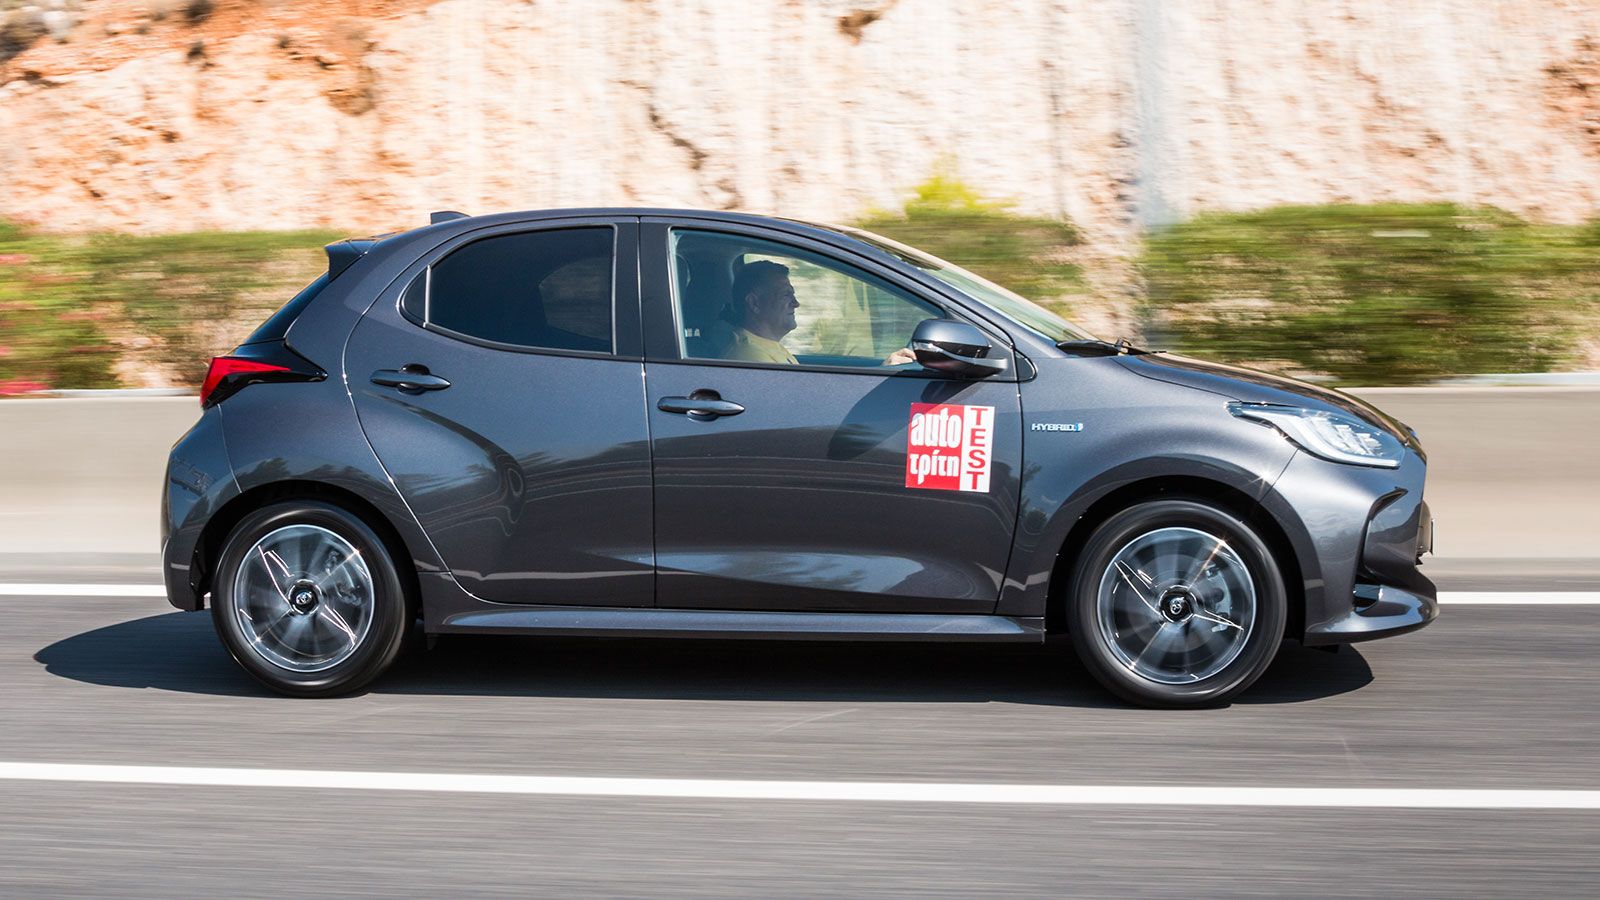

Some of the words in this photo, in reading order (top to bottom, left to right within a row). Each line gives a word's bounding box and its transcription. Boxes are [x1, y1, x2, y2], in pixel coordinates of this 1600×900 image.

[911, 407, 962, 448] auto
[1031, 423, 1075, 431] HYBRID
[910, 450, 960, 485] τρίτη
[966, 408, 988, 490] TEST
